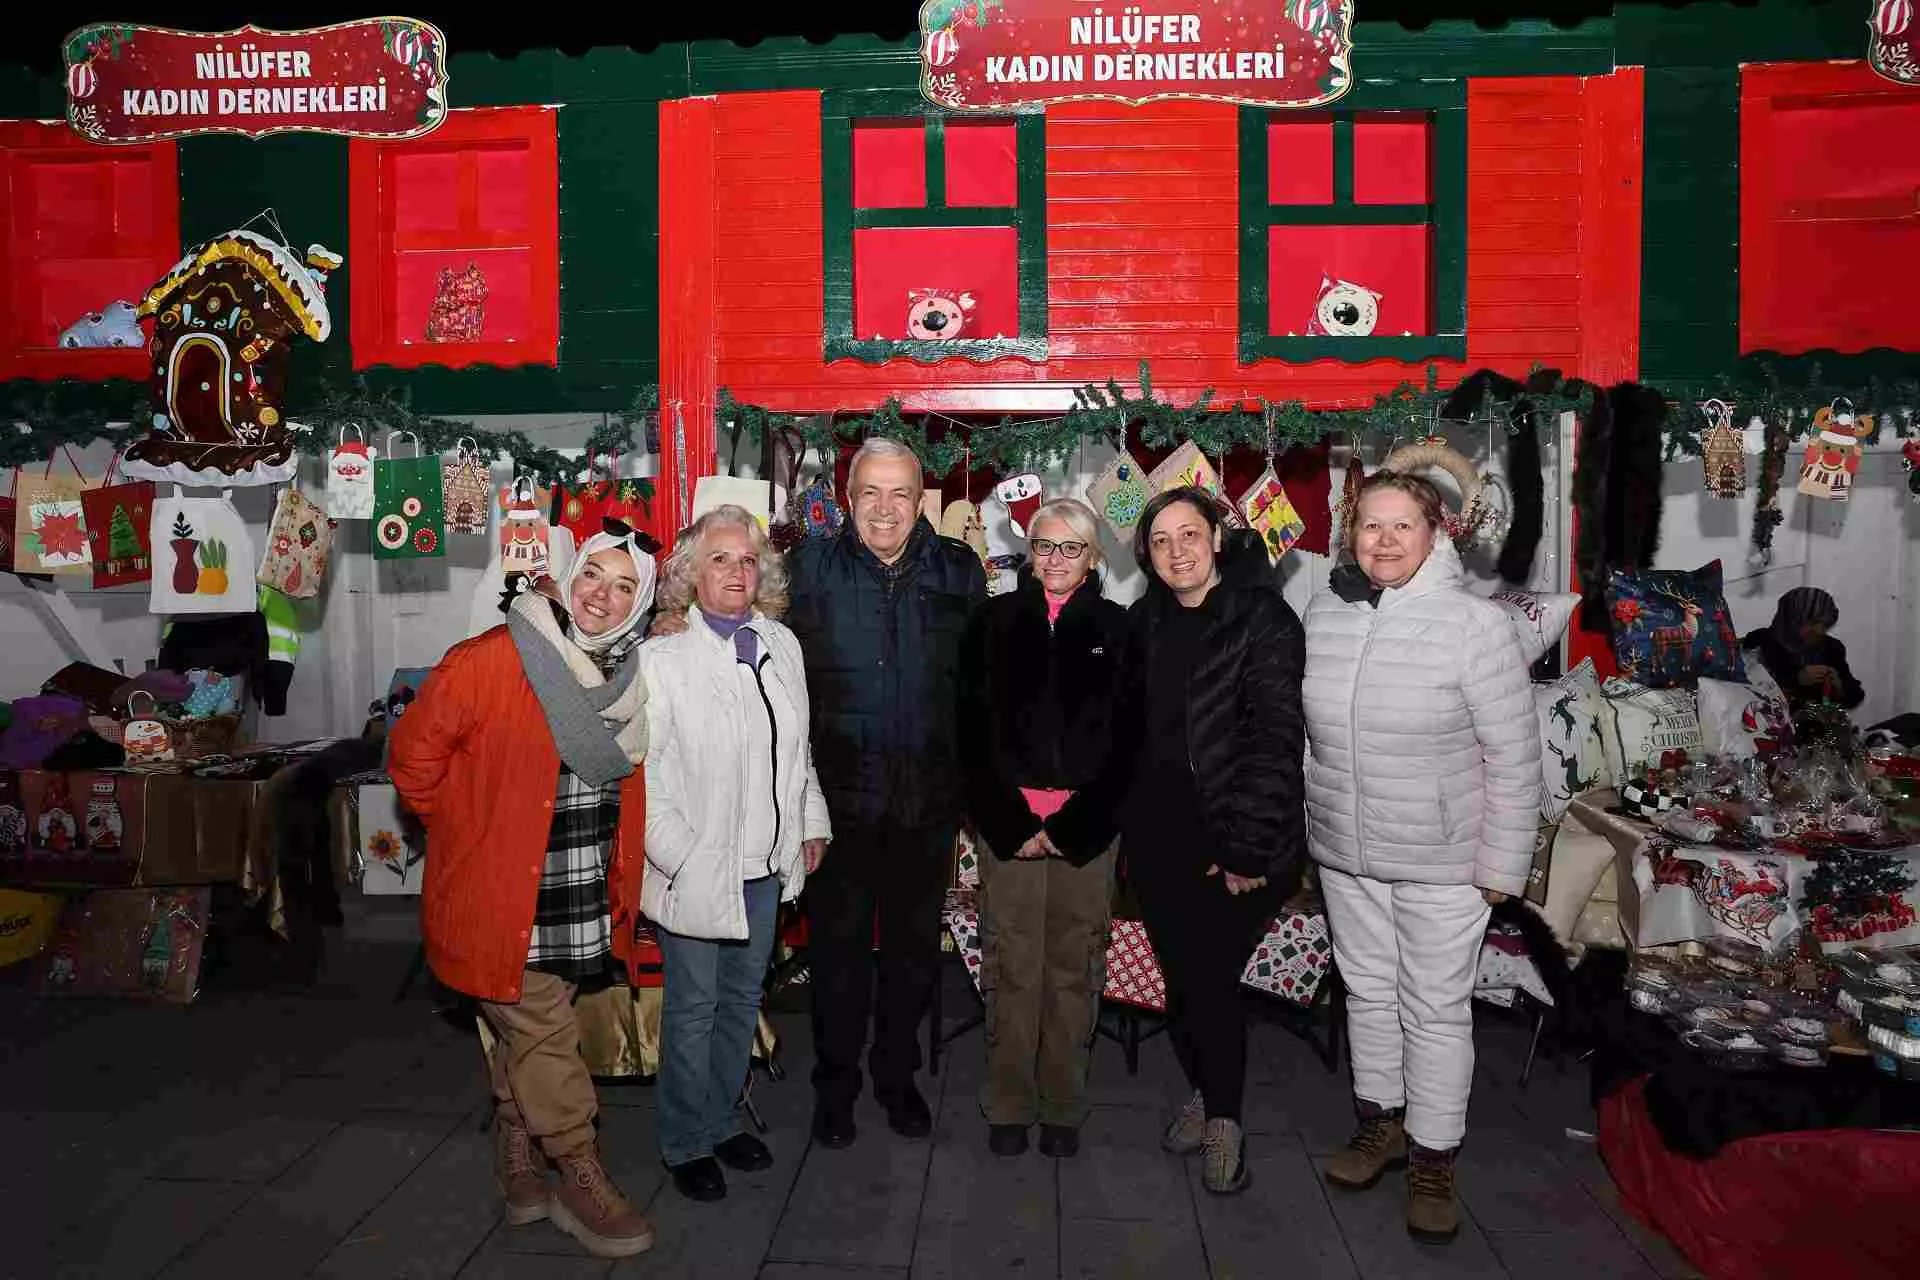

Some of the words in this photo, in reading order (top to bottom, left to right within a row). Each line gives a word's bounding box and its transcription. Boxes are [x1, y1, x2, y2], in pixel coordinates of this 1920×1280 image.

[1070, 6, 1200, 44] NİLÜFER
[195, 43, 312, 79] NİLÜFER
[985, 55, 1084, 83] KADIN
[1094, 43, 1285, 81] DERNEKLERİ
[122, 89, 209, 115] KADIN
[218, 77, 387, 114] DERNEKLERİ
